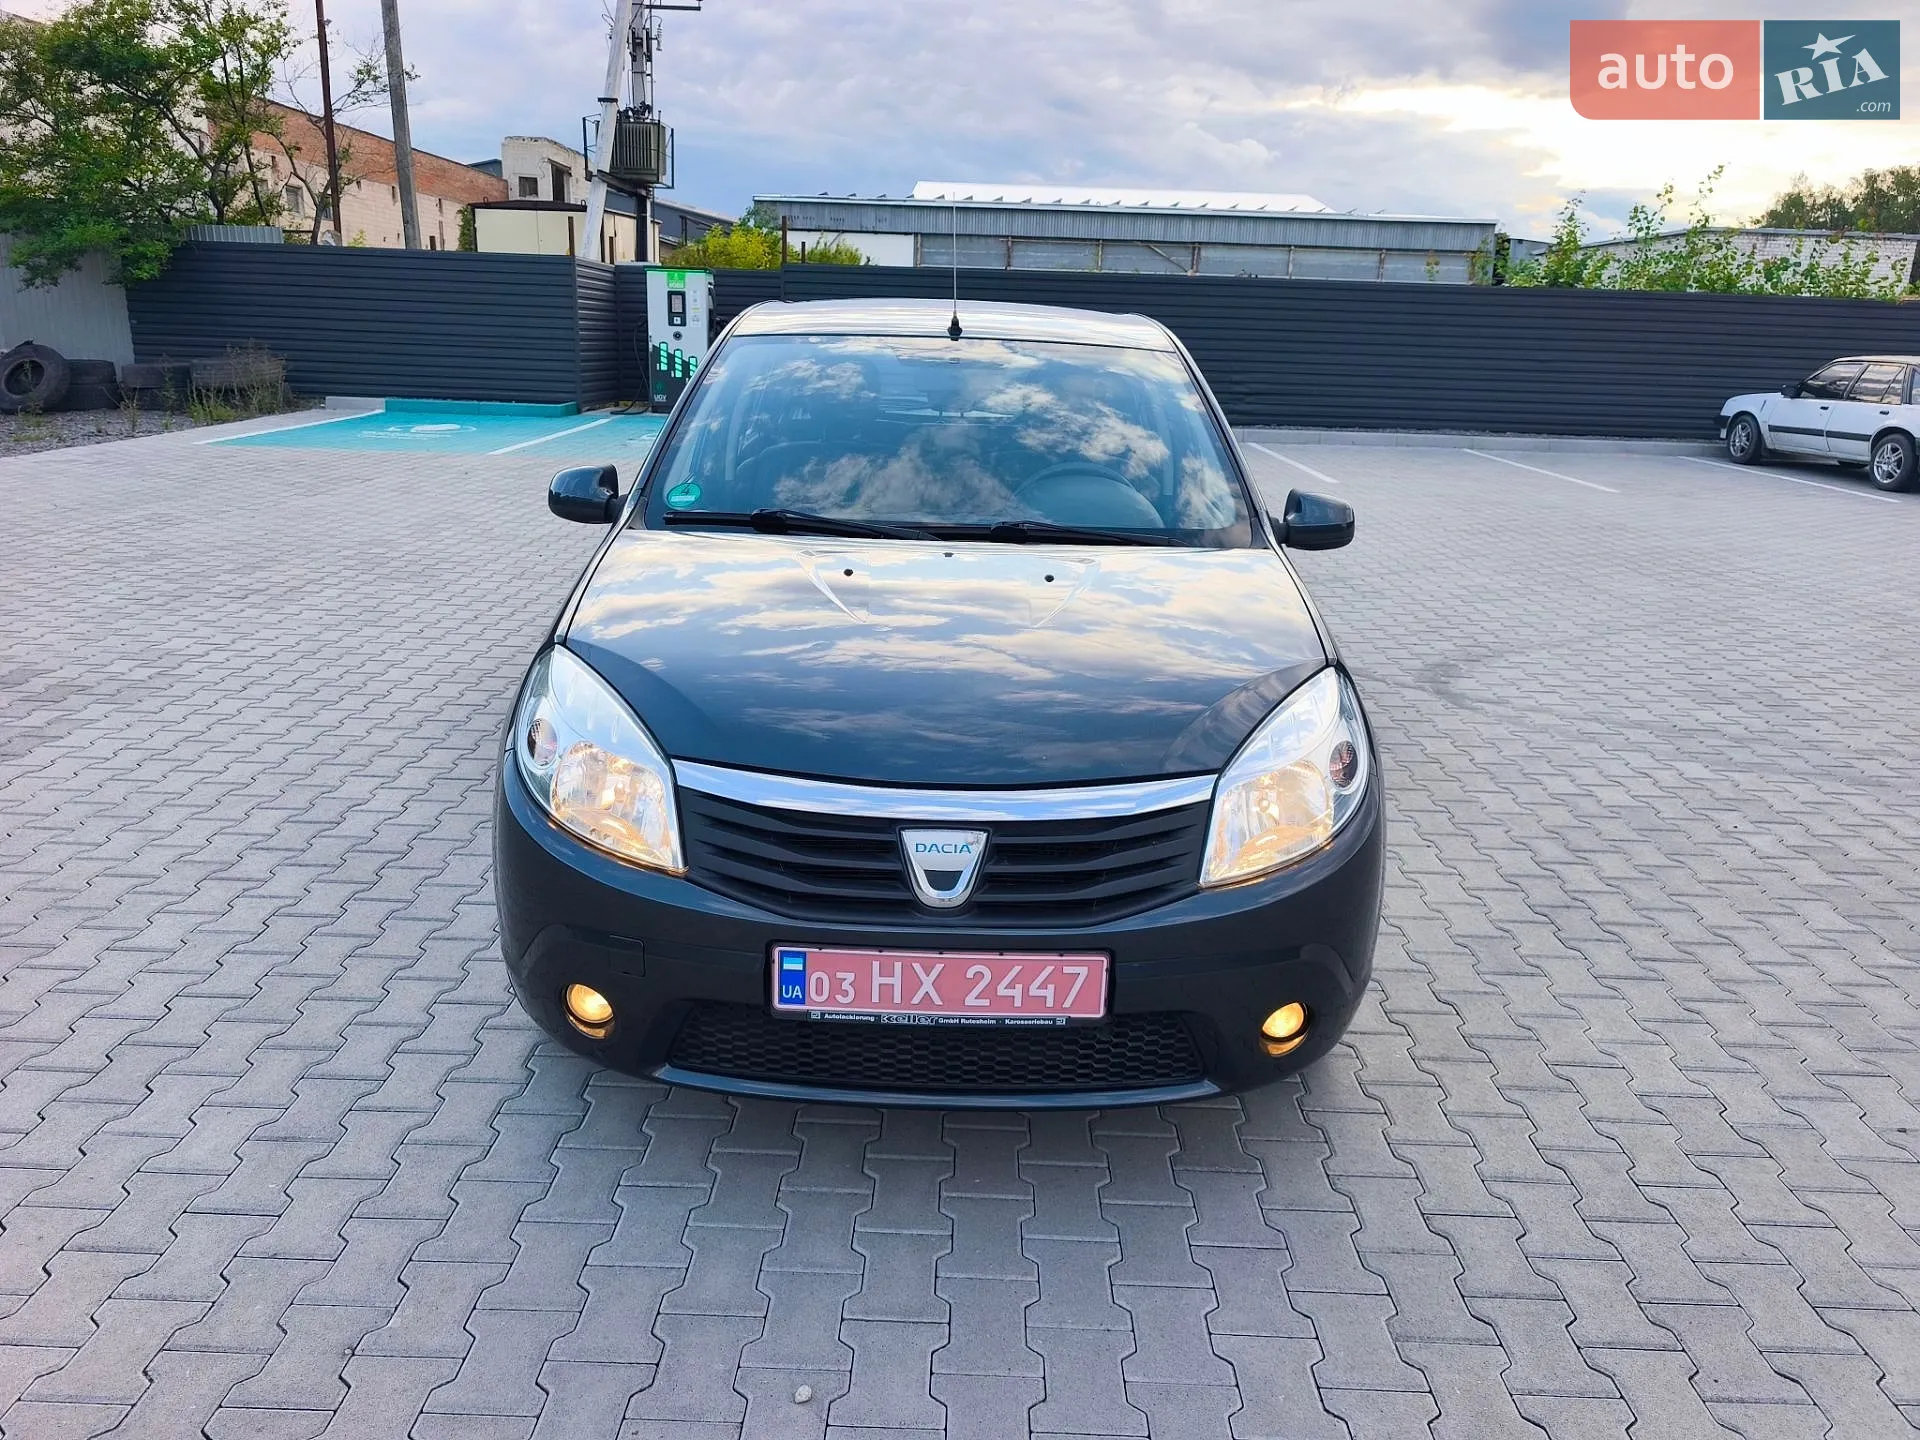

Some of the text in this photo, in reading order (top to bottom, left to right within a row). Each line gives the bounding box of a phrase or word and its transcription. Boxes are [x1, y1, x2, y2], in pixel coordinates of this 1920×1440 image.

[915, 842, 972, 854] DACIA
[808, 960, 1090, 1009] 03 HX 2447
[782, 985, 803, 999] UA
[938, 1017, 960, 1025] GmbH
